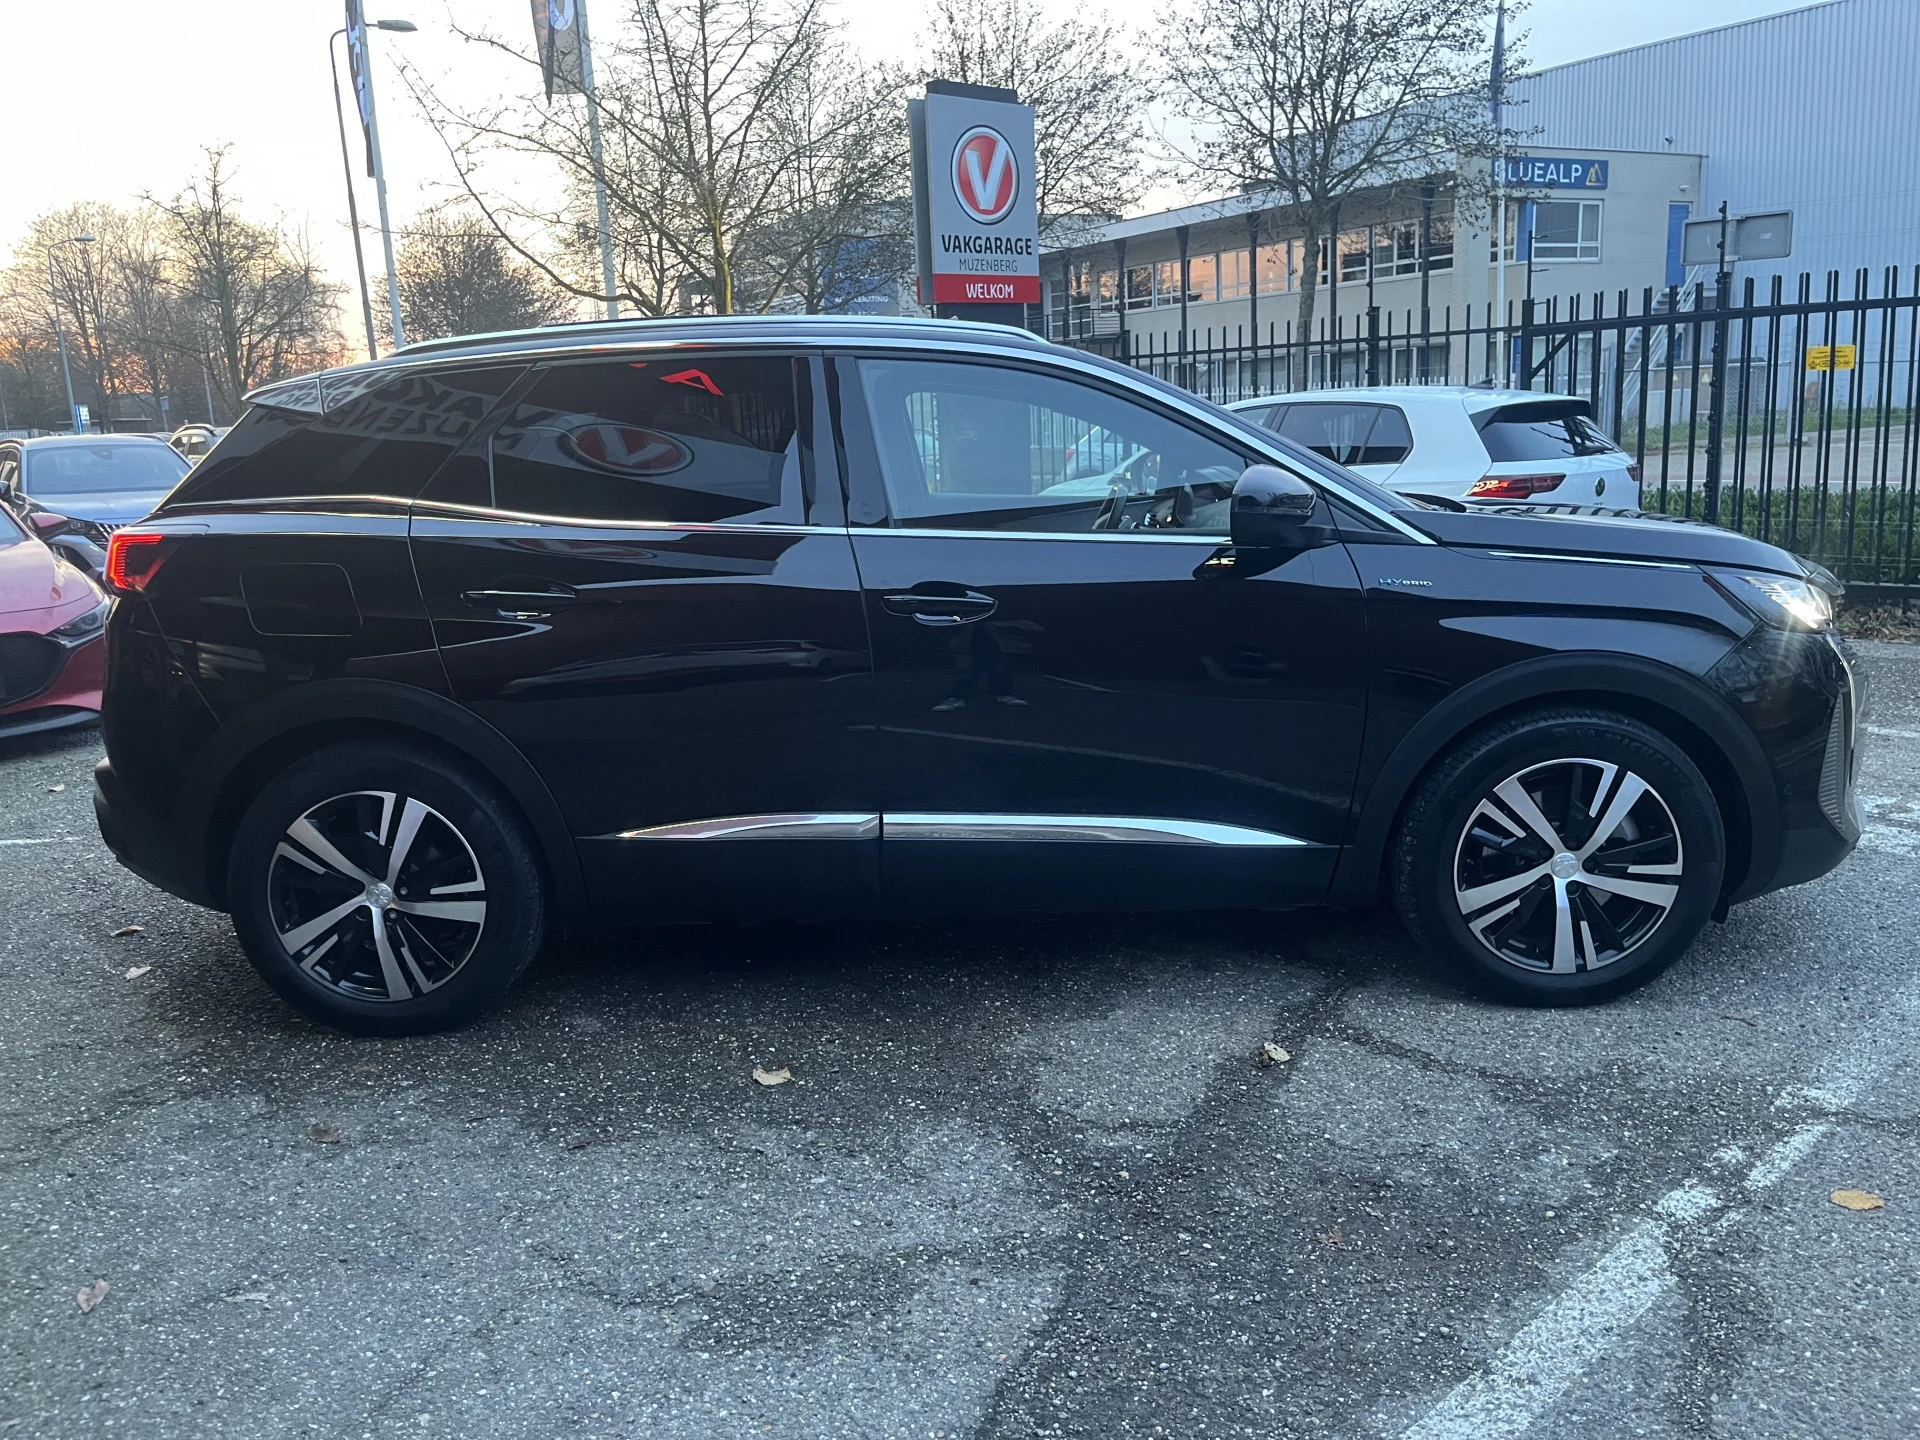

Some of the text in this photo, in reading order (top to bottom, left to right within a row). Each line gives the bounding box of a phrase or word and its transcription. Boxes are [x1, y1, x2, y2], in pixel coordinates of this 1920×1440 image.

[941, 234, 1033, 256] VAKGARAGE
[959, 258, 1018, 273] MUZENBERG
[965, 283, 1014, 299] WELKOM
[1379, 578, 1433, 587] HYBRID
